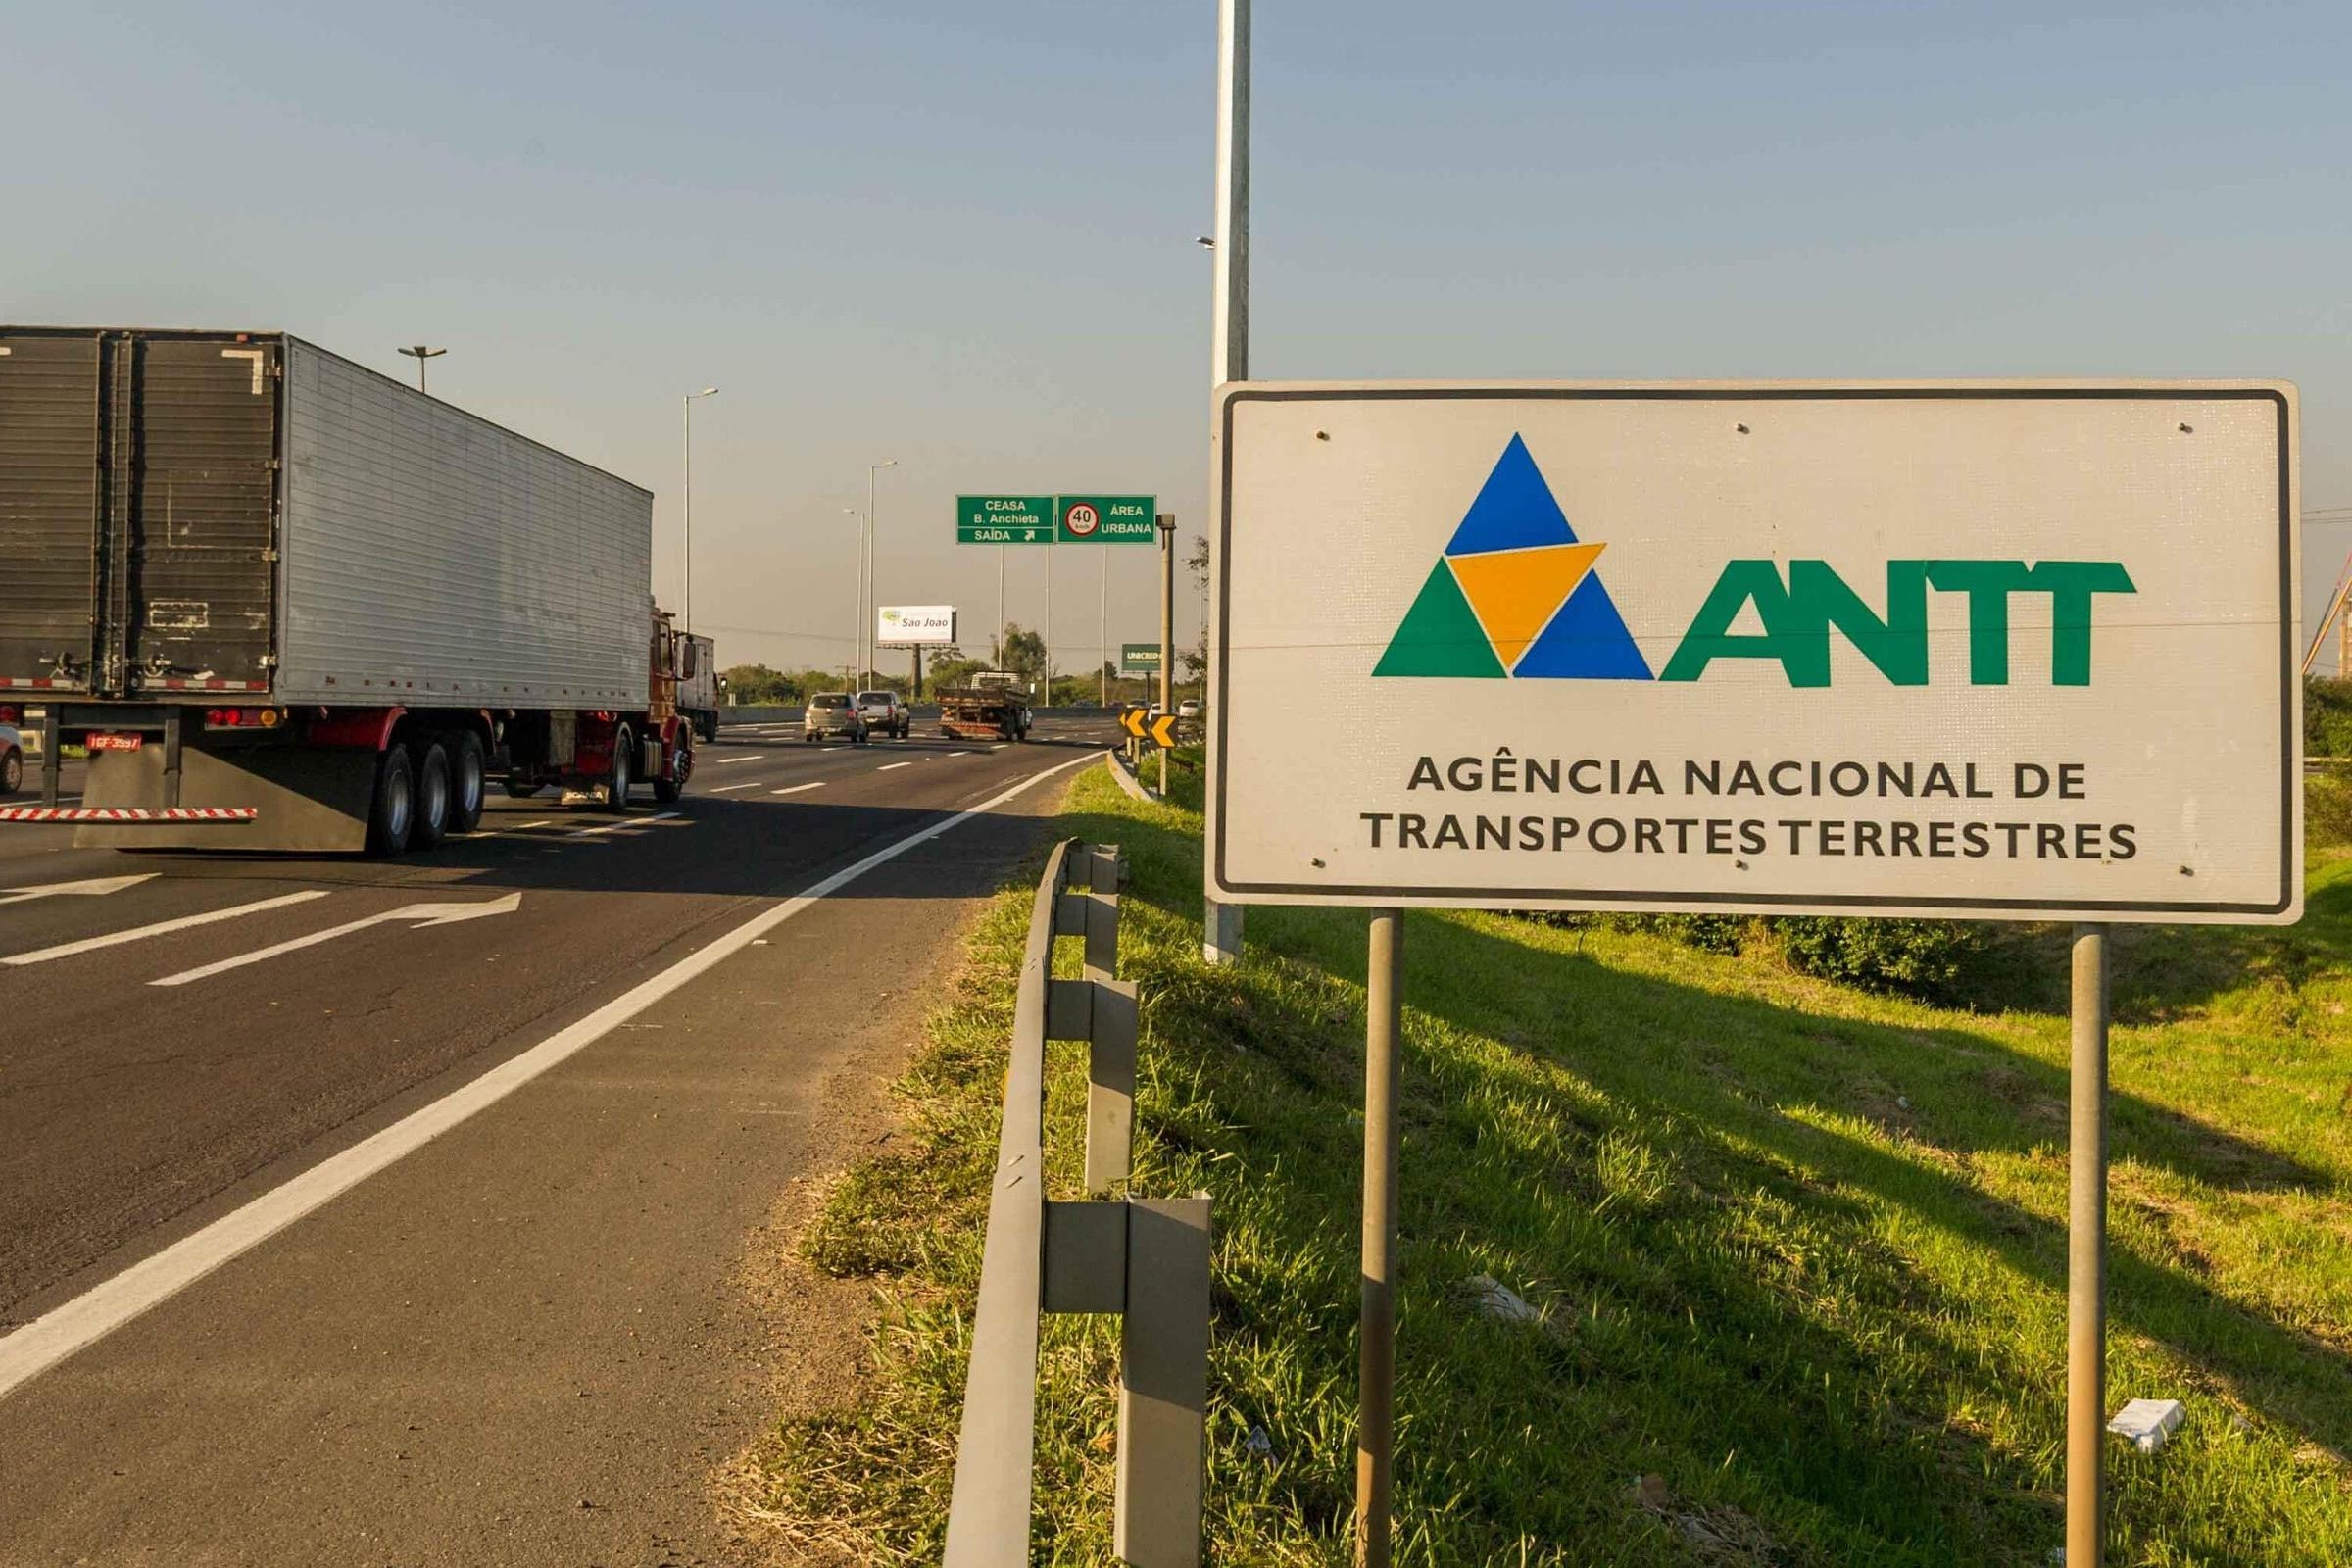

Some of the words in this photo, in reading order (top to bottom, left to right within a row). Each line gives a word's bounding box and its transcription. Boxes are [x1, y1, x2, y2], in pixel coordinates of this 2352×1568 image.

[985, 500, 1026, 511] CEASA
[1110, 503, 1144, 515] ÁREA
[974, 514, 986, 523] B.
[990, 514, 1039, 523] Anchieta
[1073, 510, 1091, 522] 40
[1102, 523, 1152, 533] URBANA
[975, 528, 1010, 541] SAÍDA
[1658, 560, 2136, 688] ANTT
[1406, 747, 1665, 795] AGÊNCIA
[1685, 760, 1993, 799] NACIONAL
[2014, 762, 2086, 800] DE
[1359, 812, 1767, 856] TRANSPORTES
[1778, 819, 2137, 859] TERRESTRES
